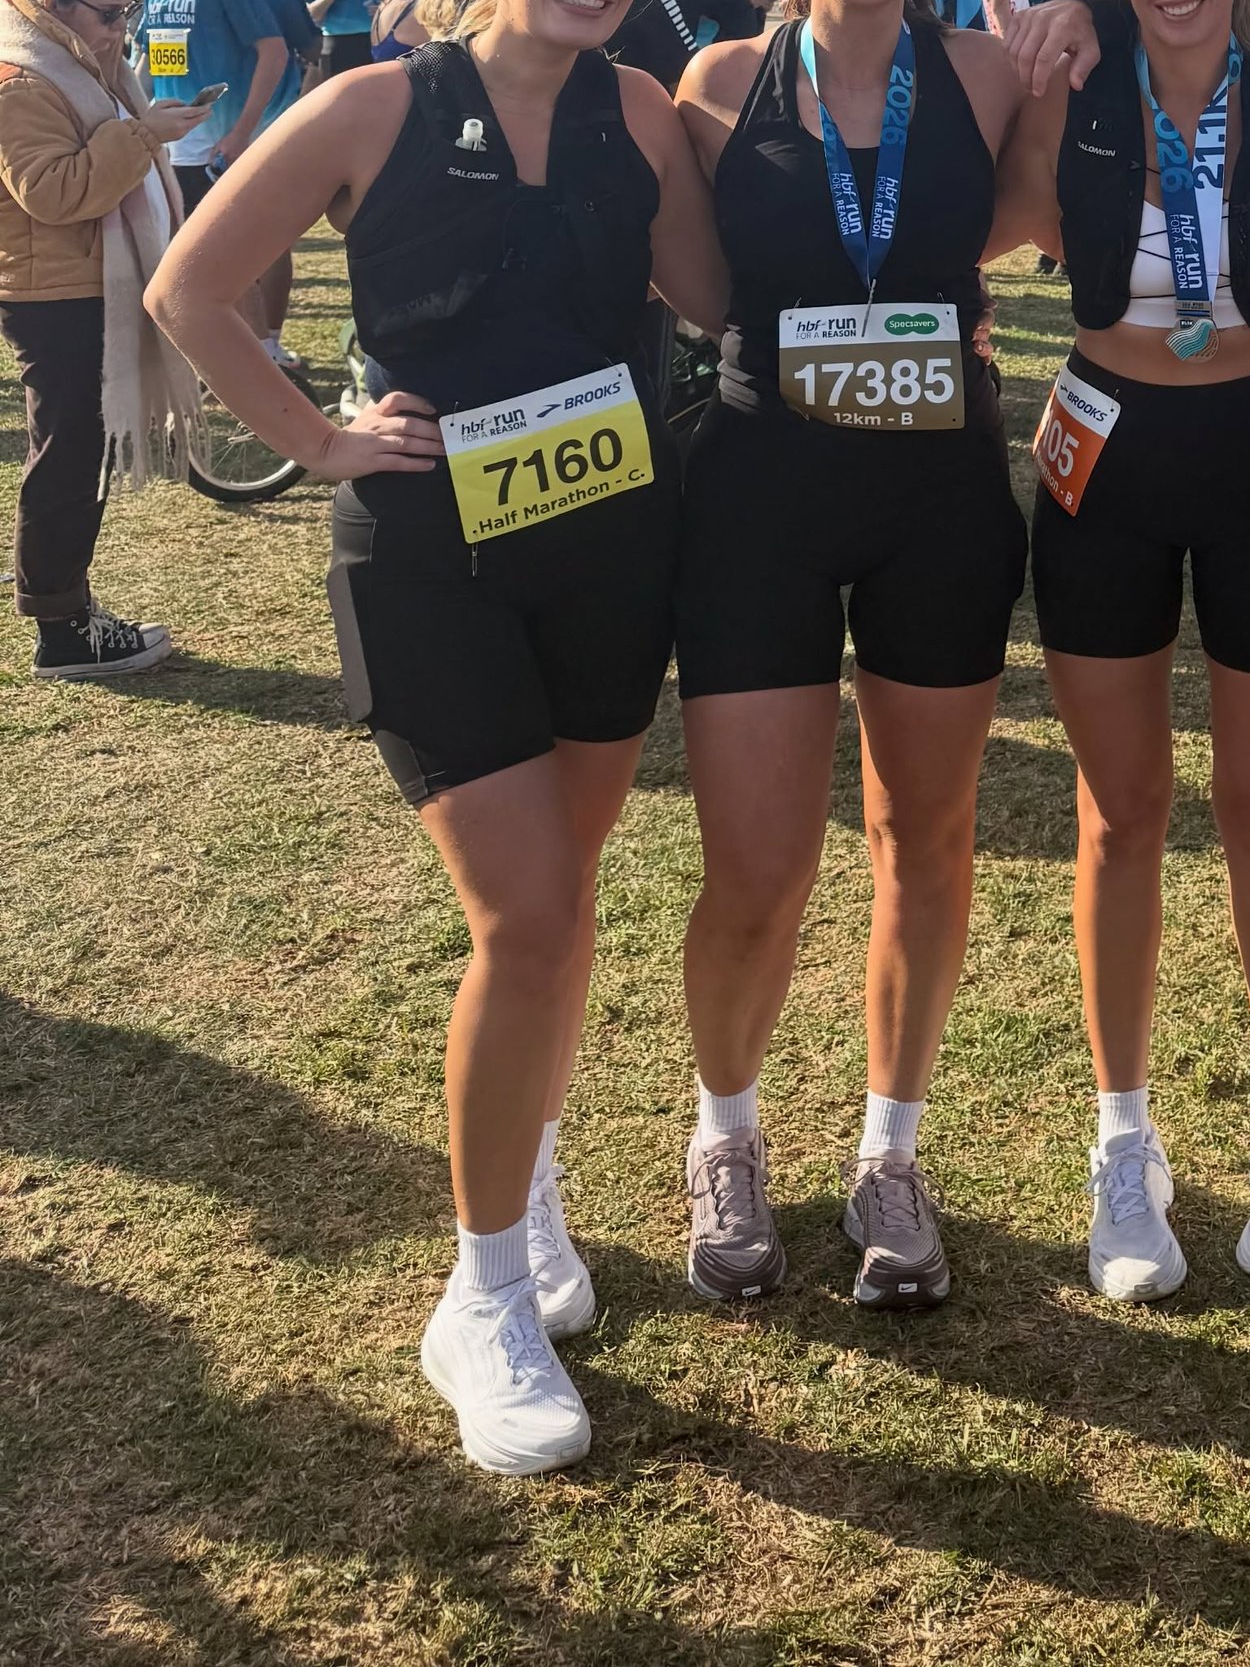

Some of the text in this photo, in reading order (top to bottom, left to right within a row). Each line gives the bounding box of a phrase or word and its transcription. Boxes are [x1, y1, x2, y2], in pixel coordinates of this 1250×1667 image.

[881, 64, 913, 145] 2026
[447, 167, 499, 181] SALOMON
[832, 173, 841, 189] FOR
[876, 176, 886, 191] FOR
[836, 199, 850, 235] REASON
[840, 173, 862, 234] hbf run
[880, 177, 899, 239] hbf run
[872, 202, 883, 238] REASON
[1170, 214, 1180, 234] FOR
[1180, 214, 1198, 244] hbf
[1174, 247, 1188, 289] REASON
[1185, 253, 1203, 288] run
[796, 329, 857, 340] FOR A REASON
[797, 317, 857, 332] hbf run
[889, 319, 936, 328] Specsavers
[564, 382, 621, 410] BROOKS
[794, 358, 954, 406] 17385
[834, 412, 881, 425] 12km
[901, 412, 914, 425] B
[1067, 391, 1108, 422] BROOKS
[461, 408, 526, 435] hbf run
[462, 420, 527, 443] FOR A REASON
[483, 428, 623, 506] 7160
[478, 507, 518, 534] Half
[523, 481, 611, 520] Marathon
[628, 469, 640, 481] C
[1065, 490, 1073, 506] B
